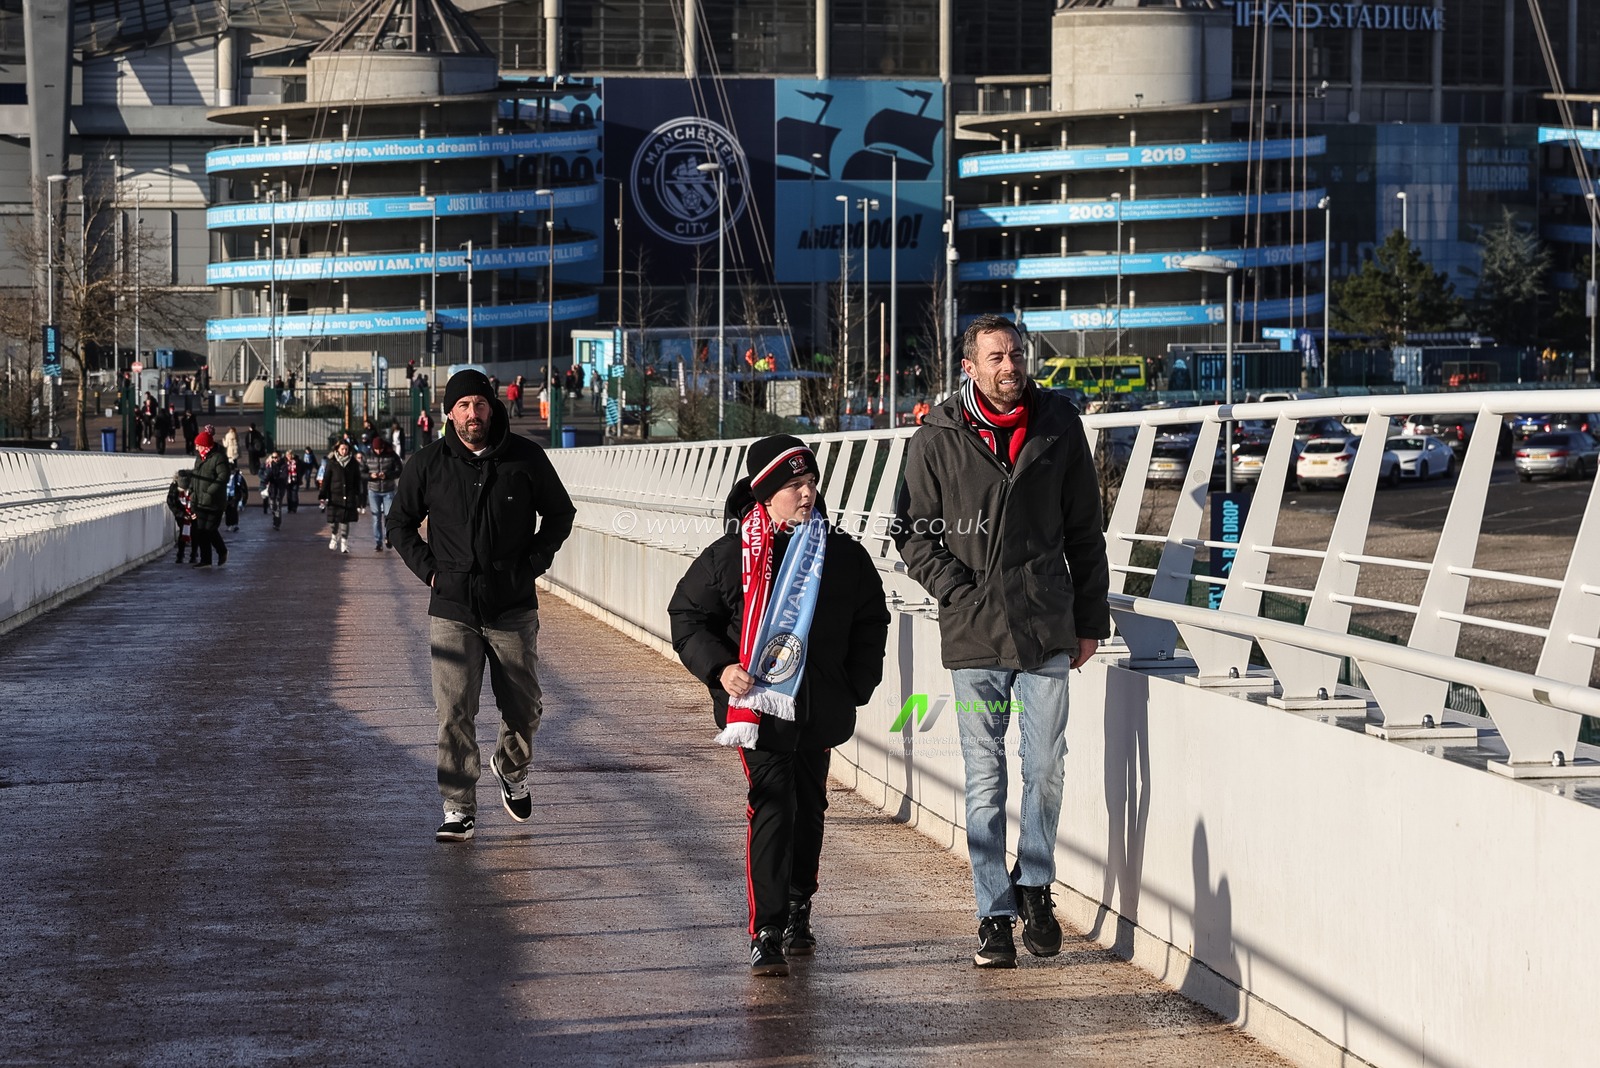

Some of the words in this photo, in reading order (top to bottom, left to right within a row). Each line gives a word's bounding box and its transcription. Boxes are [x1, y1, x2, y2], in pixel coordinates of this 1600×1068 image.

[1329, 4, 1443, 31] STADIUM
[245, 152, 263, 162] saw
[265, 150, 280, 161] me
[282, 147, 333, 161] standing
[334, 145, 372, 158] alone,
[373, 143, 424, 156] without
[427, 144, 435, 153] a
[437, 141, 477, 153] dream
[479, 140, 490, 151] in
[492, 141, 510, 152] my
[645, 127, 737, 166] MANCHESTER
[1140, 147, 1187, 163] 2019
[1467, 166, 1529, 191] WARRIOR
[315, 203, 346, 217] REALLY
[346, 201, 373, 217] HERE,
[447, 197, 469, 212] JUST
[471, 196, 489, 210] LIKE
[490, 195, 505, 209] THE
[506, 194, 526, 208] FANS
[1069, 205, 1115, 220] 2003
[675, 222, 709, 234] CITY
[249, 264, 271, 277] CITY
[304, 260, 327, 274] DIE,
[328, 260, 332, 272] I
[334, 259, 377, 273] KNOW
[379, 259, 383, 270] I
[386, 257, 414, 270] AM,
[415, 257, 434, 268] I'M
[476, 255, 481, 265] I
[482, 253, 507, 265] AM,
[508, 252, 526, 263] I'M
[527, 250, 550, 262] CITY
[1264, 249, 1292, 263] 1970
[987, 264, 1017, 277] 1956
[283, 322, 305, 331] when
[334, 320, 347, 329] are
[350, 320, 374, 331] grey,
[374, 317, 401, 328] You'll
[402, 317, 427, 326] neve
[459, 313, 477, 323] jut
[478, 311, 498, 321] how
[500, 309, 523, 320] much
[528, 307, 544, 317] love
[1070, 312, 1115, 327] 1894
[1223, 500, 1239, 533] DROP
[1222, 534, 1238, 558] BG
[779, 526, 822, 629] MANCHE
